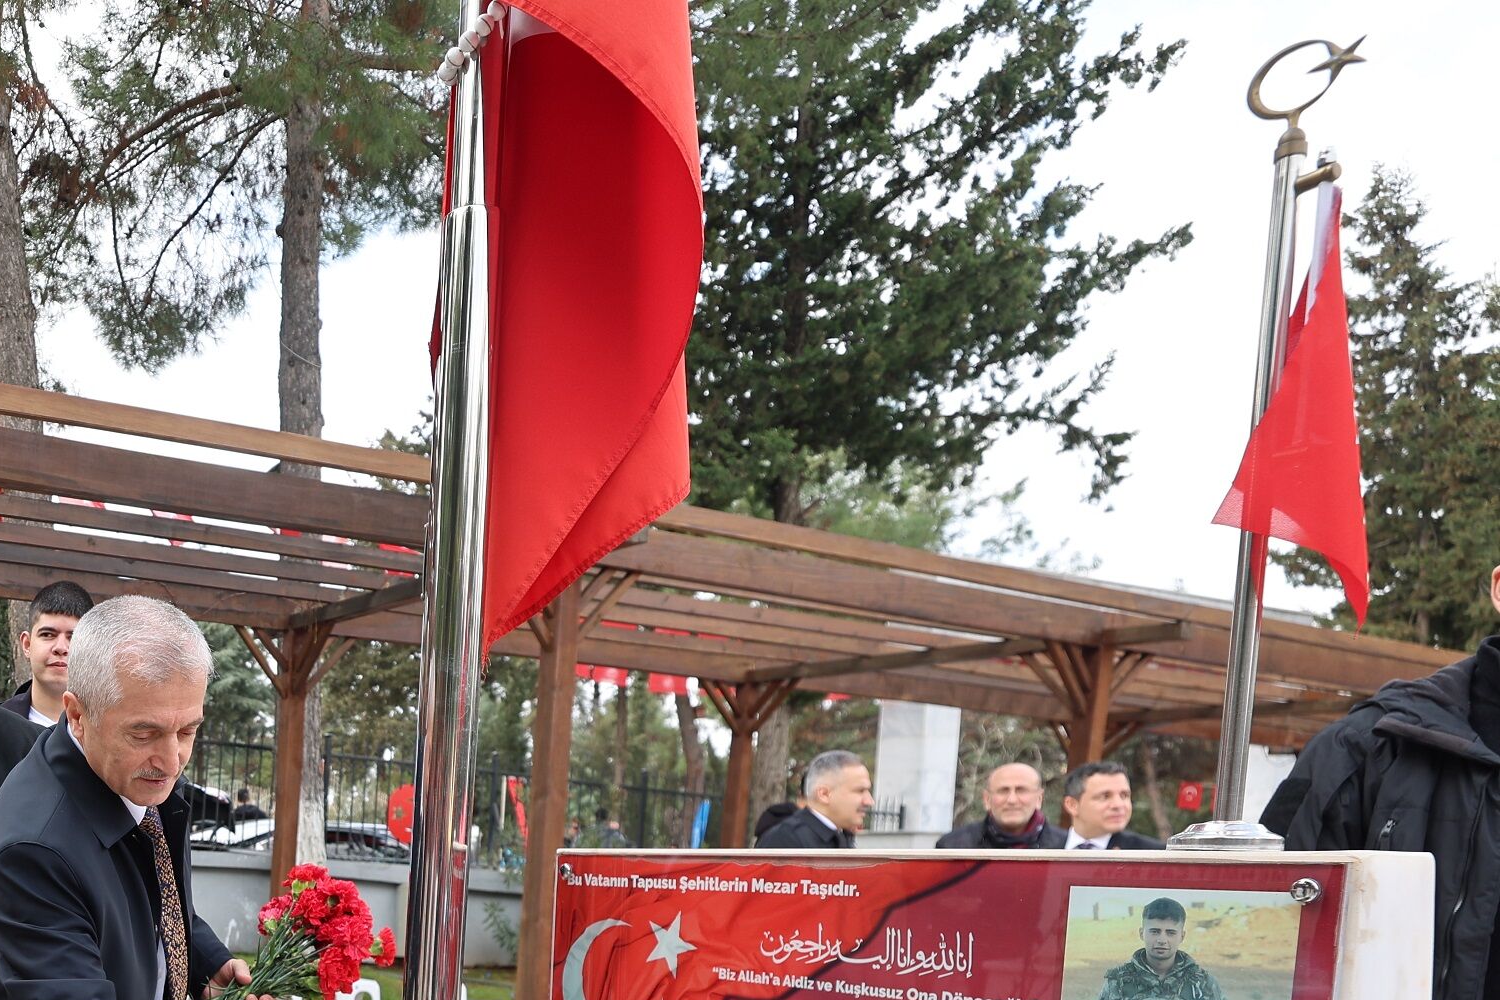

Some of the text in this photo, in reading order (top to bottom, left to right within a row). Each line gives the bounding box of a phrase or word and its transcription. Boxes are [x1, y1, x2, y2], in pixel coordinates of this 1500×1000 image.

[567, 873, 860, 900] Bu Vatanın Tapusu Şehitlerin Mezar Taşıdır.
[783, 974, 814, 991] Aidiz
[816, 981, 832, 993] ve
[835, 980, 904, 1000] Kuşkusuz
